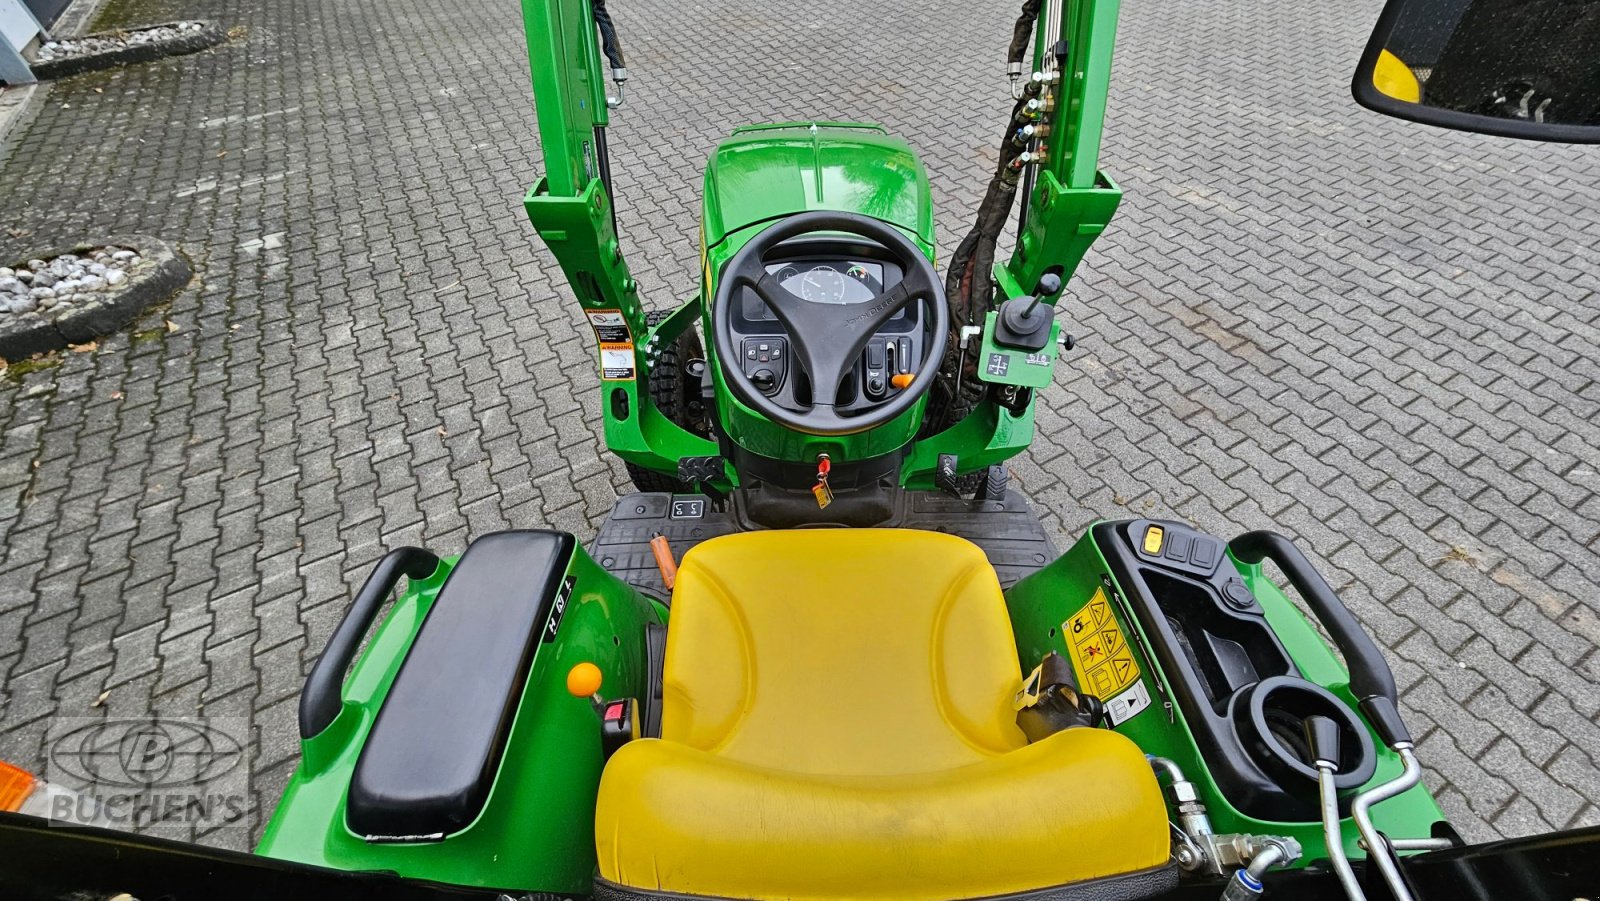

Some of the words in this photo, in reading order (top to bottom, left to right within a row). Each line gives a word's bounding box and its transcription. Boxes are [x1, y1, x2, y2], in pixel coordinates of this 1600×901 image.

[845, 312, 869, 327] JOHN
[869, 295, 896, 316] DEERE
[549, 617, 556, 633] H
